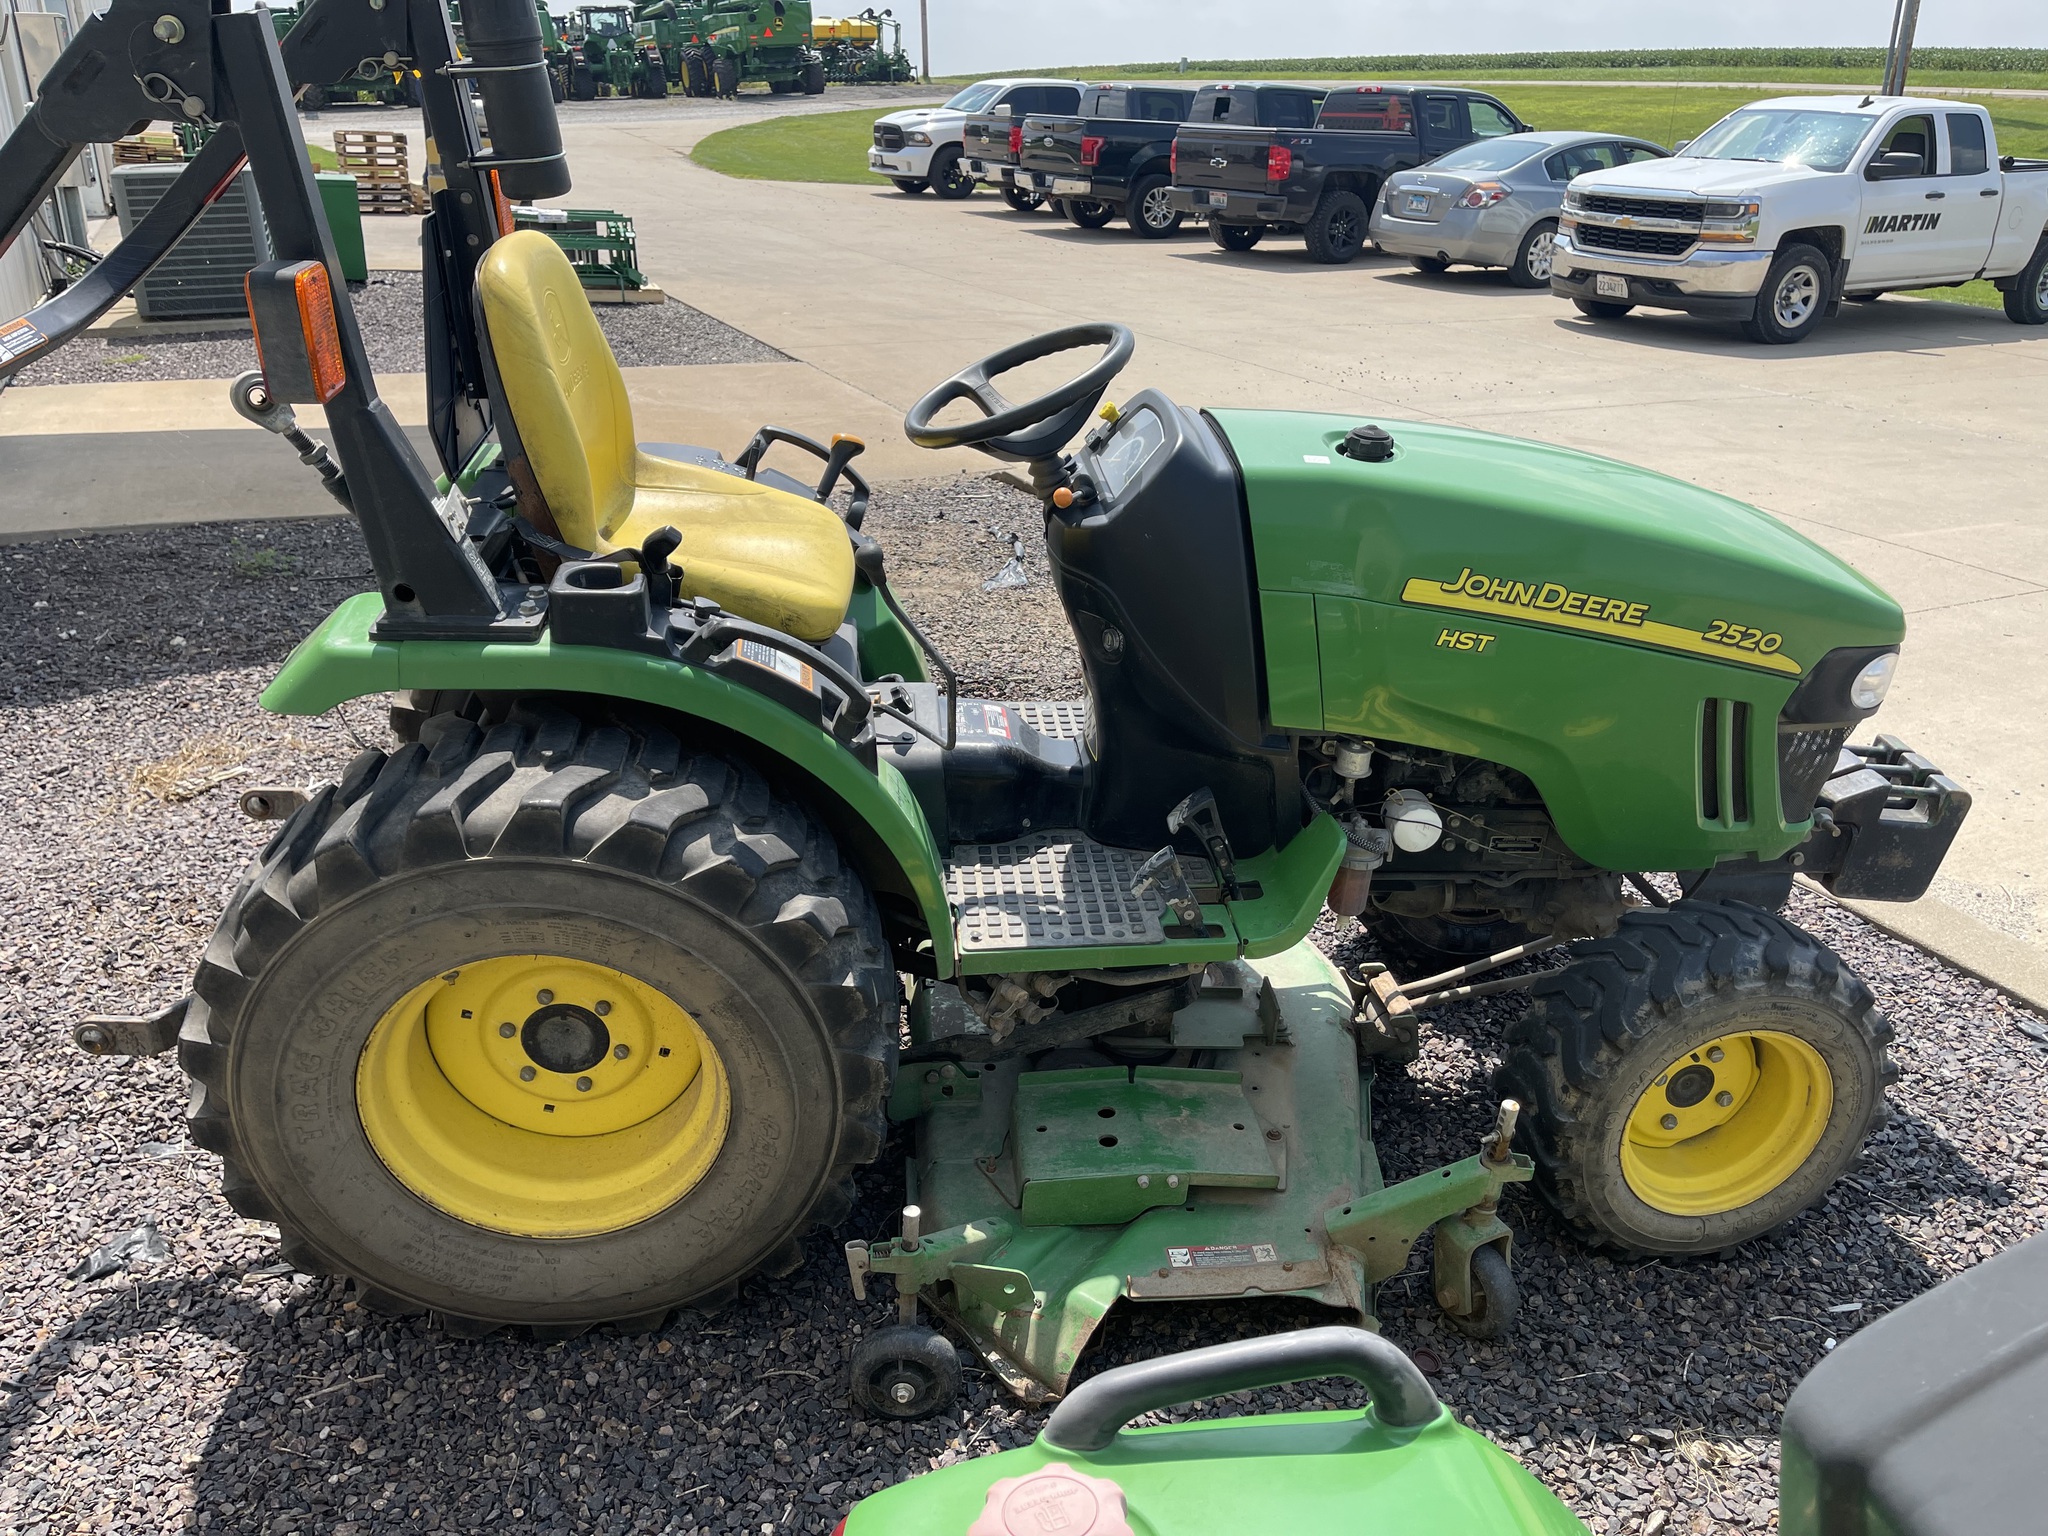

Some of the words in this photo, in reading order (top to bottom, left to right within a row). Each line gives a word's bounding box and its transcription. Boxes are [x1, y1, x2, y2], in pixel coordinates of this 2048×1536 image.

[1864, 213, 1941, 234] MARTIN
[1441, 567, 1537, 607] JOHN
[1534, 582, 1649, 626] DEERE
[1435, 629, 1496, 653] HST
[1701, 619, 1783, 654] 2520
[1718, 1144, 1841, 1236] CARLISLE
